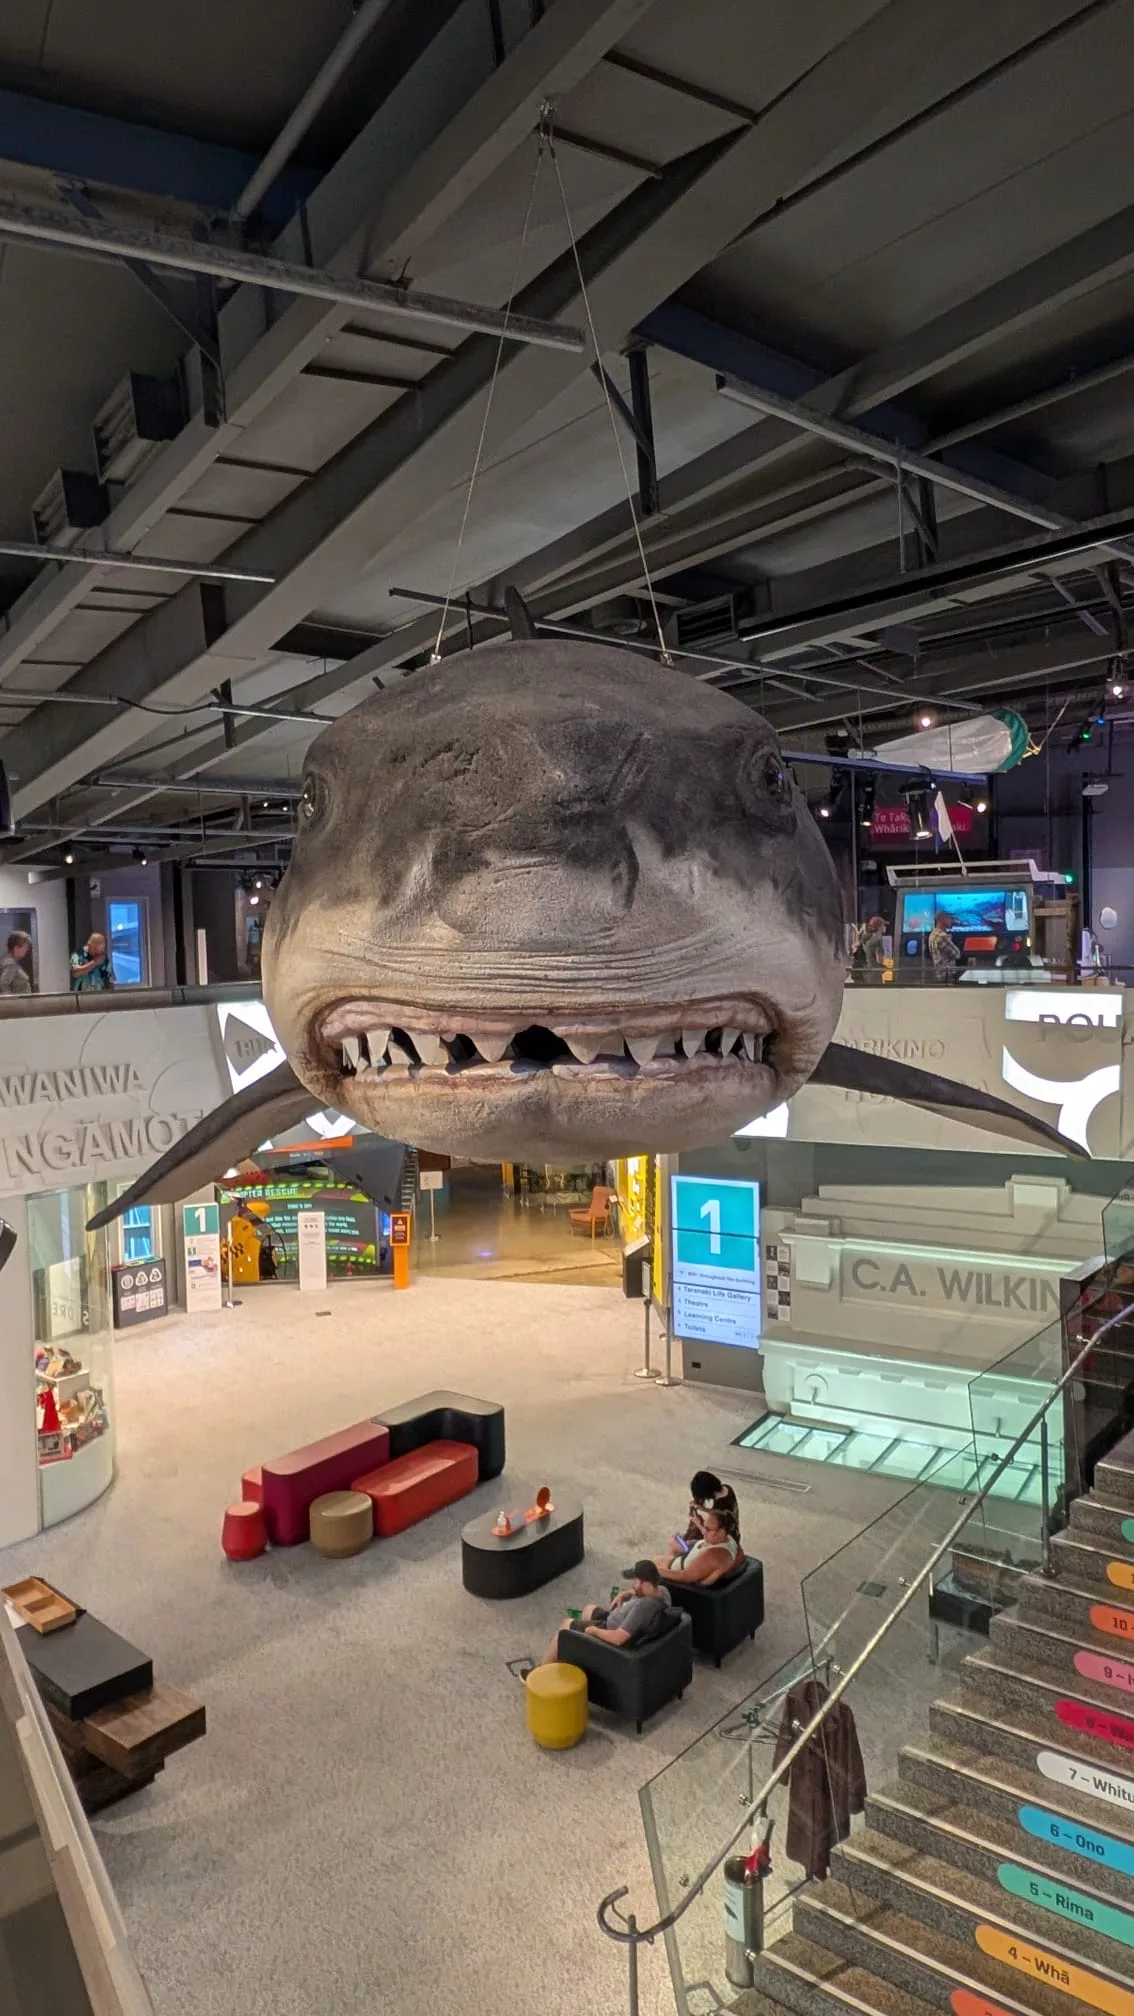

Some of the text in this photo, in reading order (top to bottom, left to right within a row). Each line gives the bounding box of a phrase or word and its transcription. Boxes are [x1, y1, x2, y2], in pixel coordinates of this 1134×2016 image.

[195, 1207, 206, 1232] 1
[700, 1200, 721, 1255] 1
[852, 1258, 926, 1297] C.A.
[684, 1286, 752, 1302] Taranaki Life Gallery
[684, 1298, 709, 1308] Theatre
[684, 1311, 737, 1325] Learning Centre
[684, 1323, 706, 1333] Toilets
[1112, 1616, 1128, 1631] 10
[1104, 1666, 1113, 1678] 9
[1068, 1767, 1077, 1780] 7
[1050, 1823, 1060, 1837] 6
[1076, 1834, 1105, 1856] Ono
[1030, 1881, 1039, 1896] 5
[1055, 1892, 1094, 1921] Rima
[1008, 1946, 1017, 1960] 4
[1034, 1957, 1071, 1985] Whā
